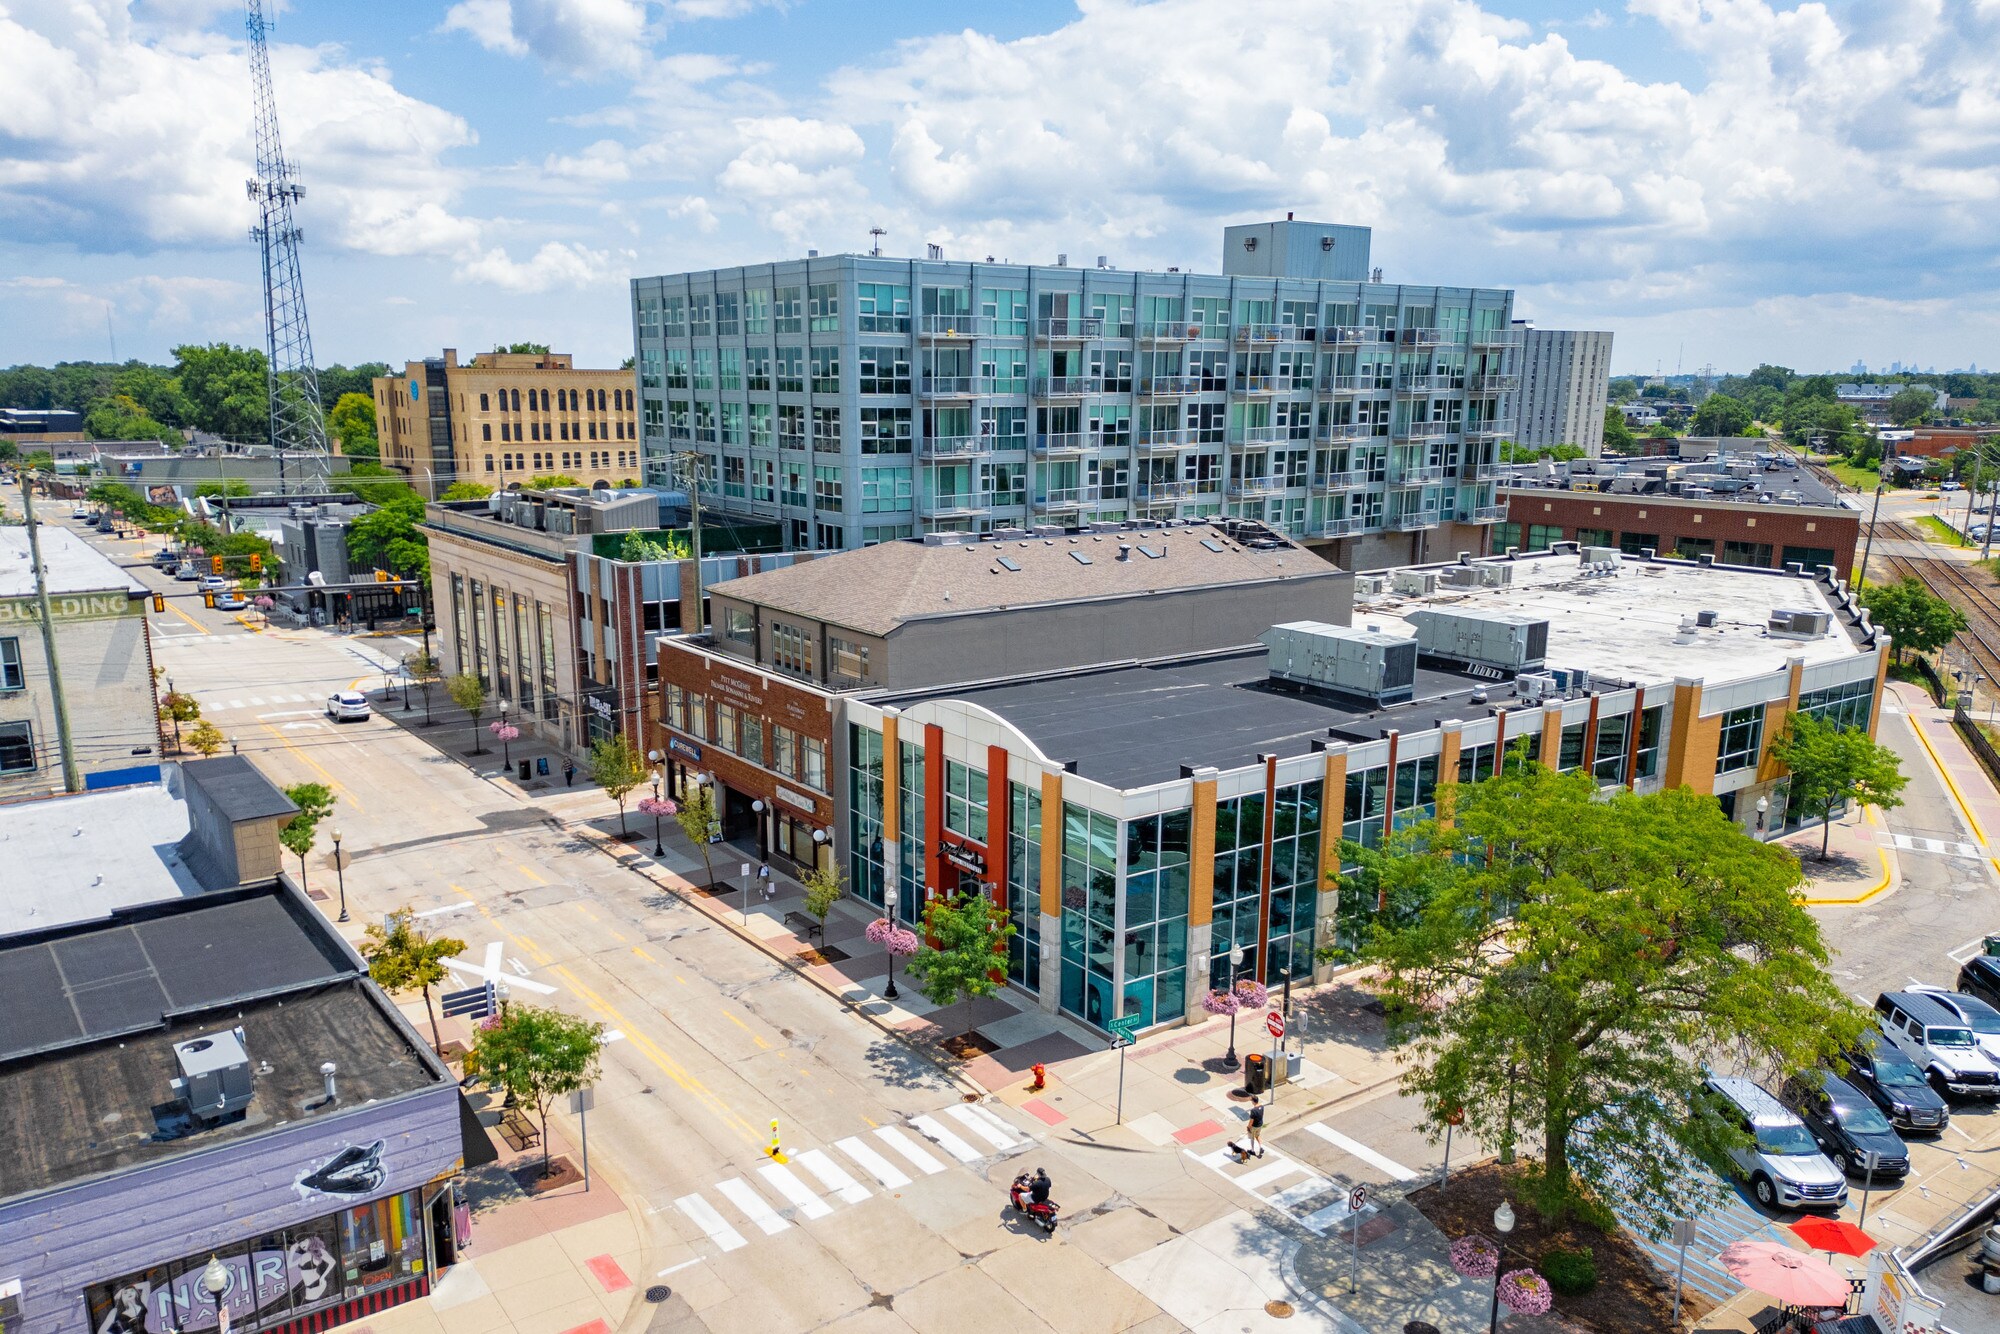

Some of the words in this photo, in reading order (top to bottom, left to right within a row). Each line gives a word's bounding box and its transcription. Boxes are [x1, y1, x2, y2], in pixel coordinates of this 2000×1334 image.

[1113, 1018, 1132, 1028] Center
[157, 1256, 285, 1318] NOIR
[362, 1272, 392, 1287] OPEN
